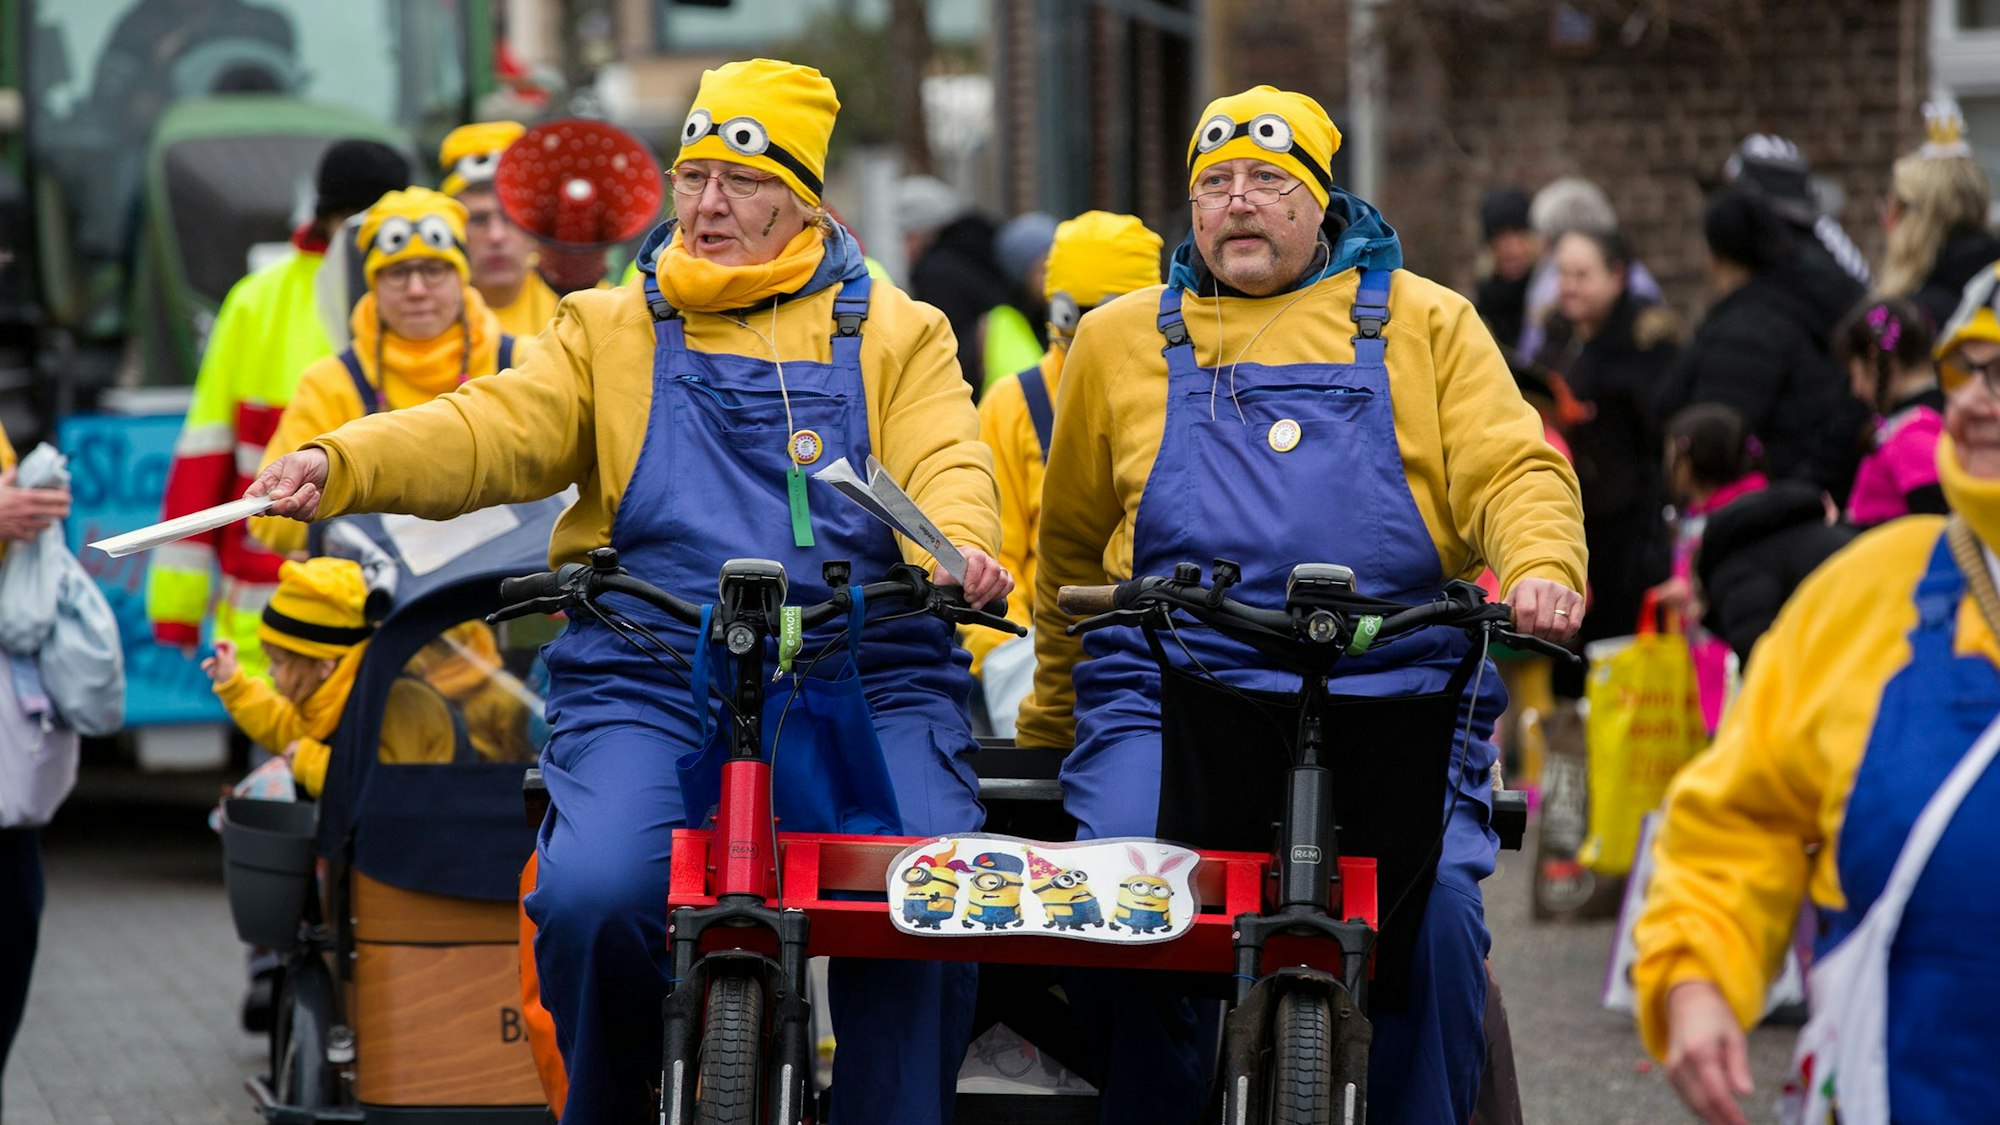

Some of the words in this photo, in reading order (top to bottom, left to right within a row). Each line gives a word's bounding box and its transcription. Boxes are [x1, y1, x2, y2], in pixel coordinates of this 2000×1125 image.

[783, 606, 795, 646] e-moti
[1294, 849, 1318, 859] R&M
[502, 1006, 529, 1043] B
